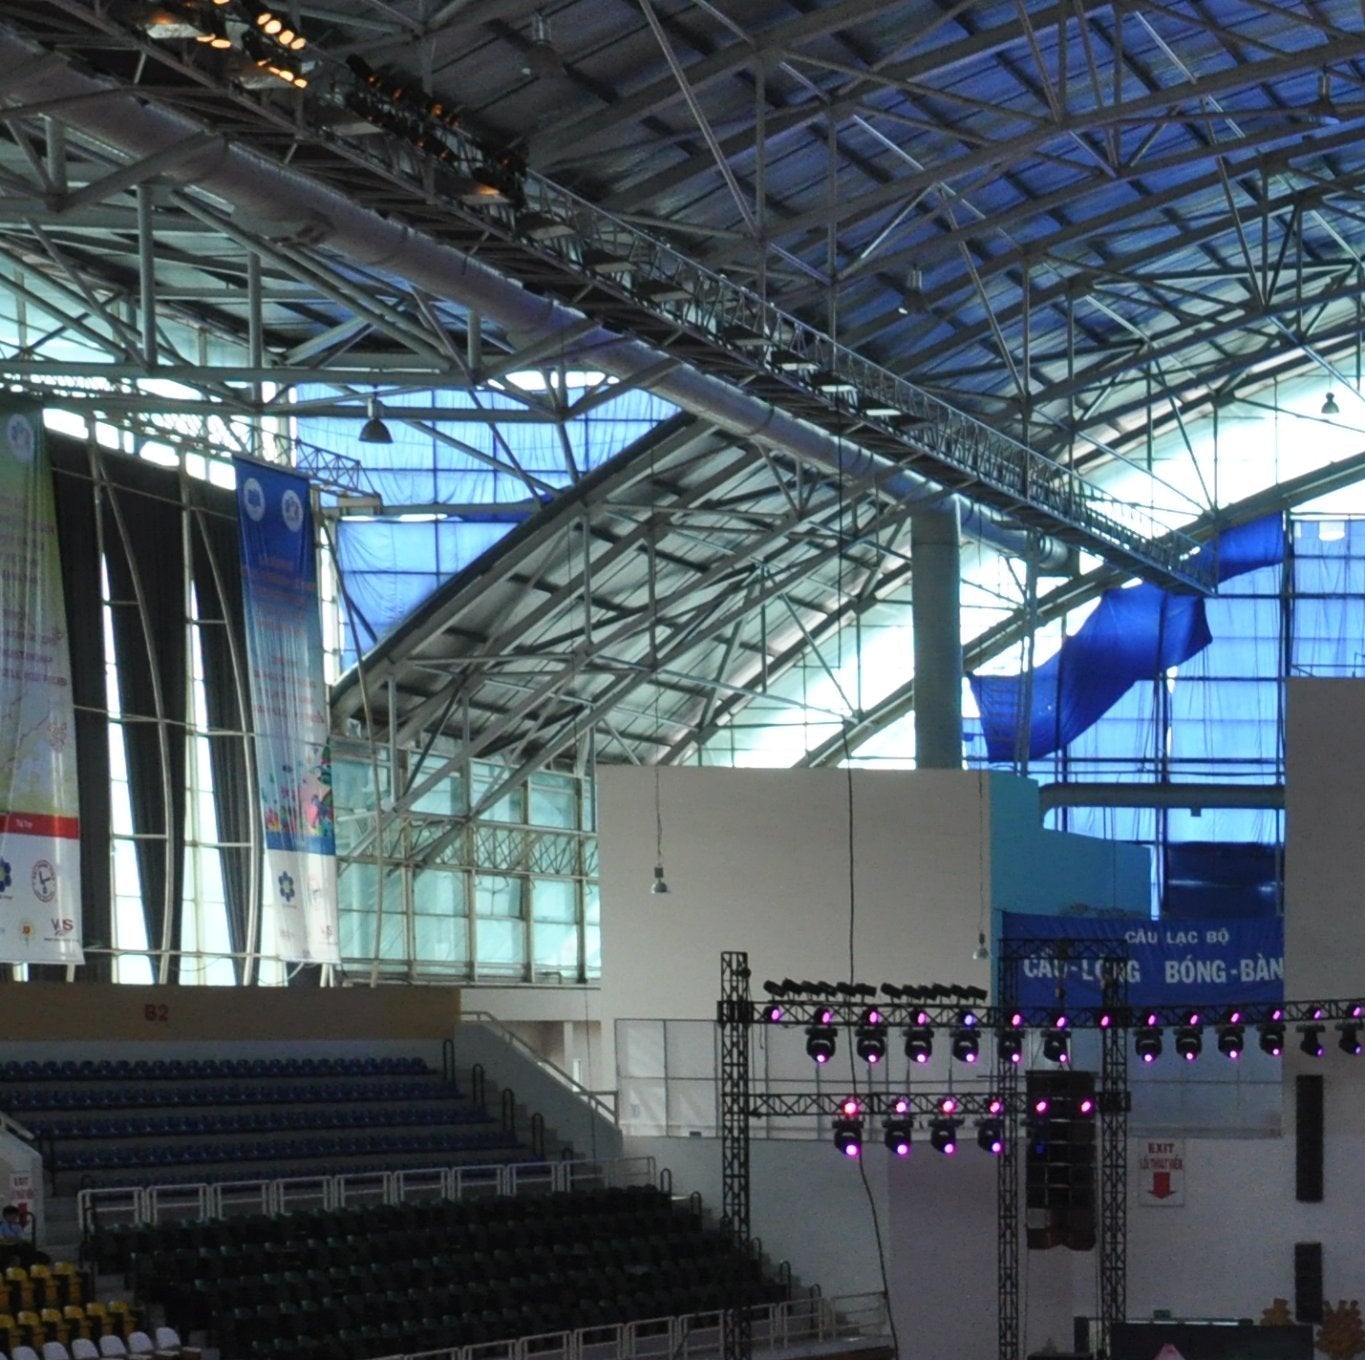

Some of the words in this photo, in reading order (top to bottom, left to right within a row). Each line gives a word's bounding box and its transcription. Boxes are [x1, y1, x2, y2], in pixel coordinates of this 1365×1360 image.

[1167, 931, 1198, 947] LẠC
[1206, 928, 1230, 945] BỘ
[145, 1003, 169, 1021] B2
[1148, 1143, 1174, 1154] EXIT
